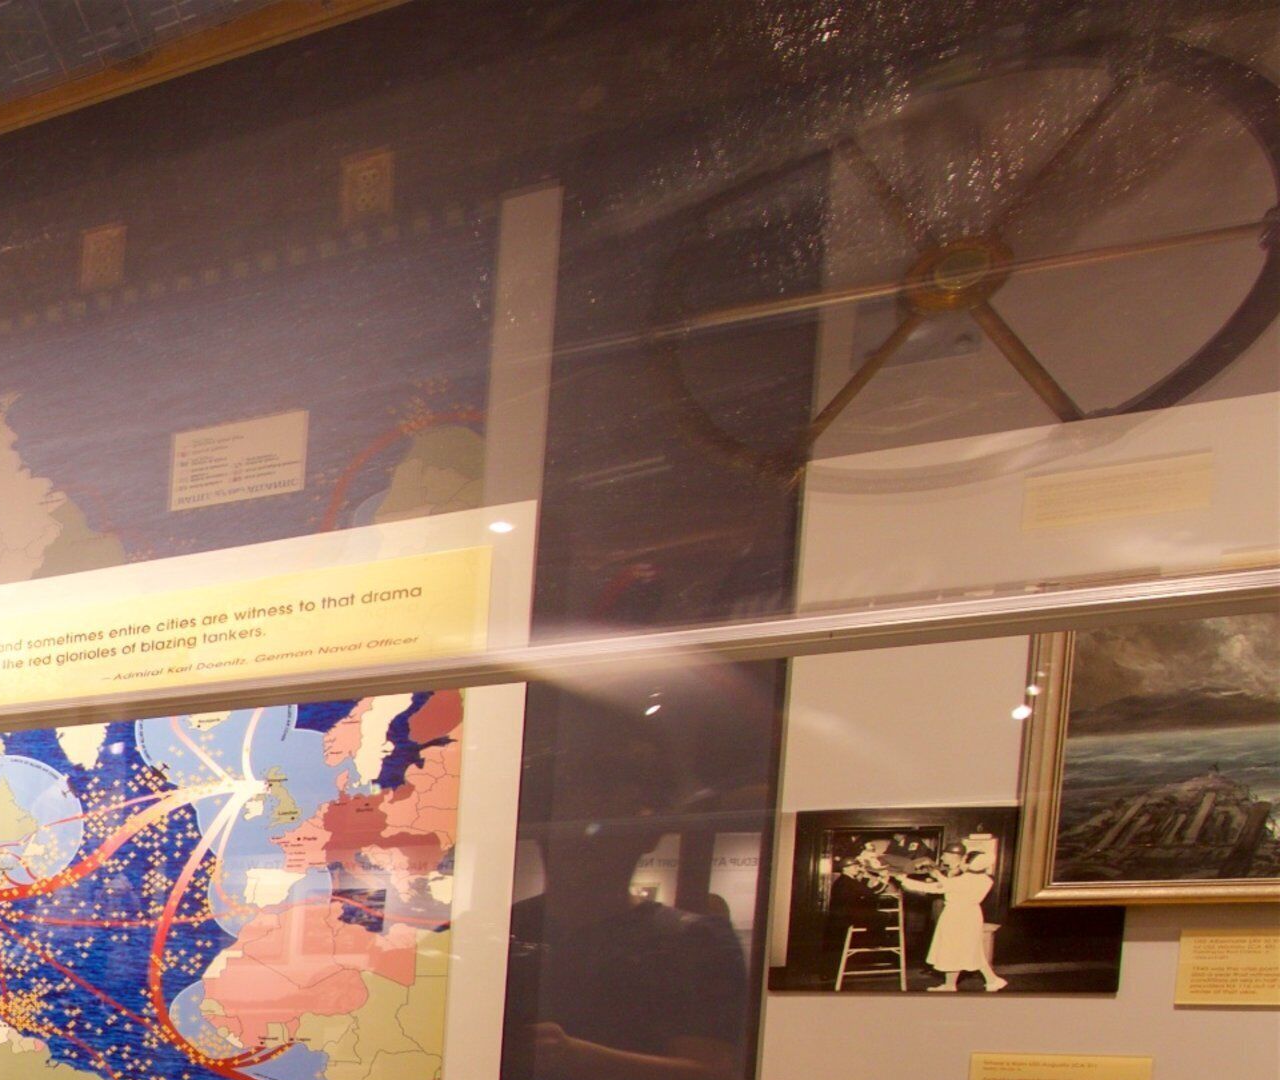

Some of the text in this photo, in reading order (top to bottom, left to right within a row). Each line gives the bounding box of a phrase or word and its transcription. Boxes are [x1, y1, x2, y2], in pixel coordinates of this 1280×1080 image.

[27, 630, 104, 650] sometimes
[108, 623, 151, 640] entire
[156, 616, 197, 633] cities
[202, 612, 228, 627] are
[233, 603, 294, 622] witness
[299, 599, 316, 613] to
[321, 593, 356, 610] that
[360, 585, 423, 605] drama
[28, 654, 52, 667] red
[56, 646, 117, 666] glorioles
[121, 643, 137, 655] of
[140, 636, 197, 654] blazing
[202, 626, 266, 645] tankers.
[254, 648, 314, 663] German
[318, 642, 362, 655] Naval
[366, 635, 420, 650] Officer
